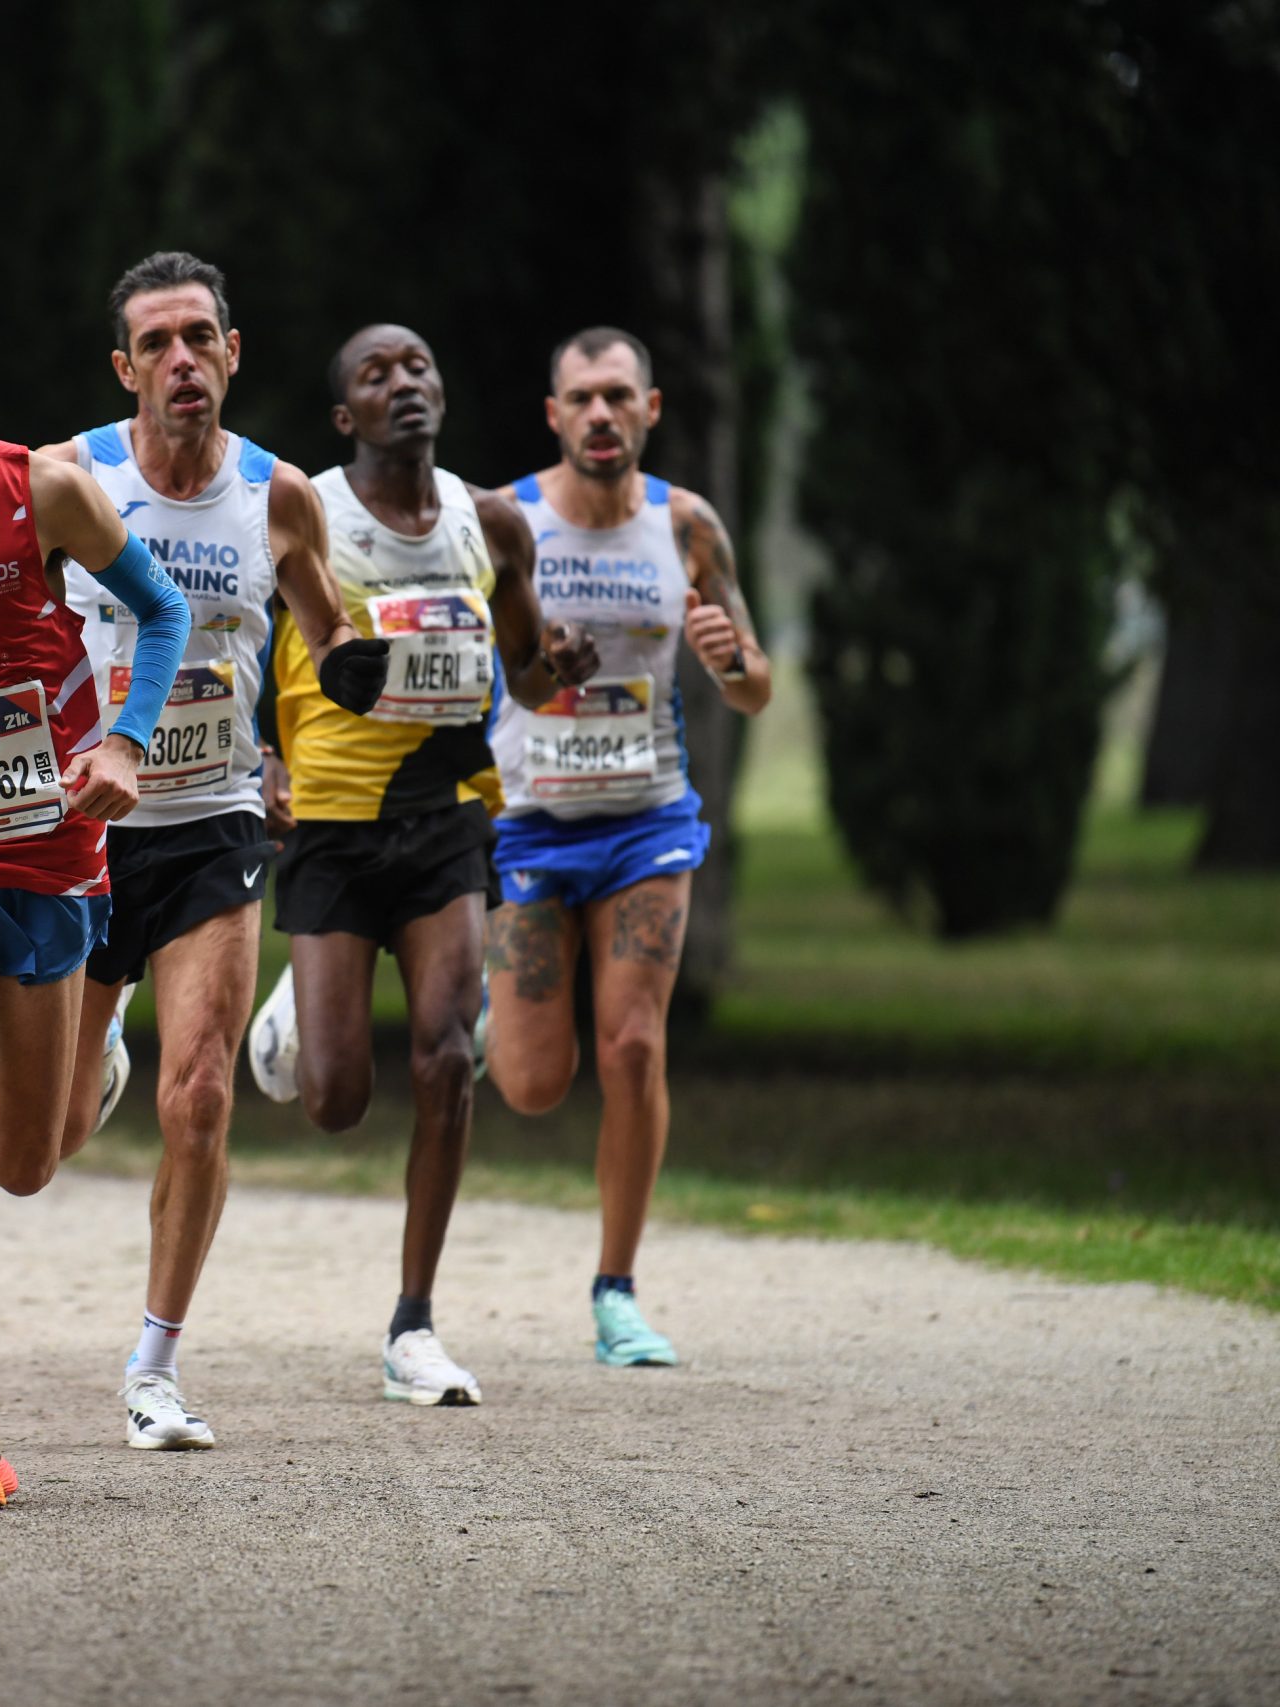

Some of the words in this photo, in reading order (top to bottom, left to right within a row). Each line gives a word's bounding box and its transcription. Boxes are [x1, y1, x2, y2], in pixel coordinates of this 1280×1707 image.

[140, 537, 239, 569] NAMO
[164, 566, 238, 596] NING
[540, 556, 659, 582] DINAMO
[540, 580, 661, 605] RUNNING
[404, 651, 461, 691] NJERI
[4, 712, 30, 730] 21K
[555, 734, 626, 771] H3024
